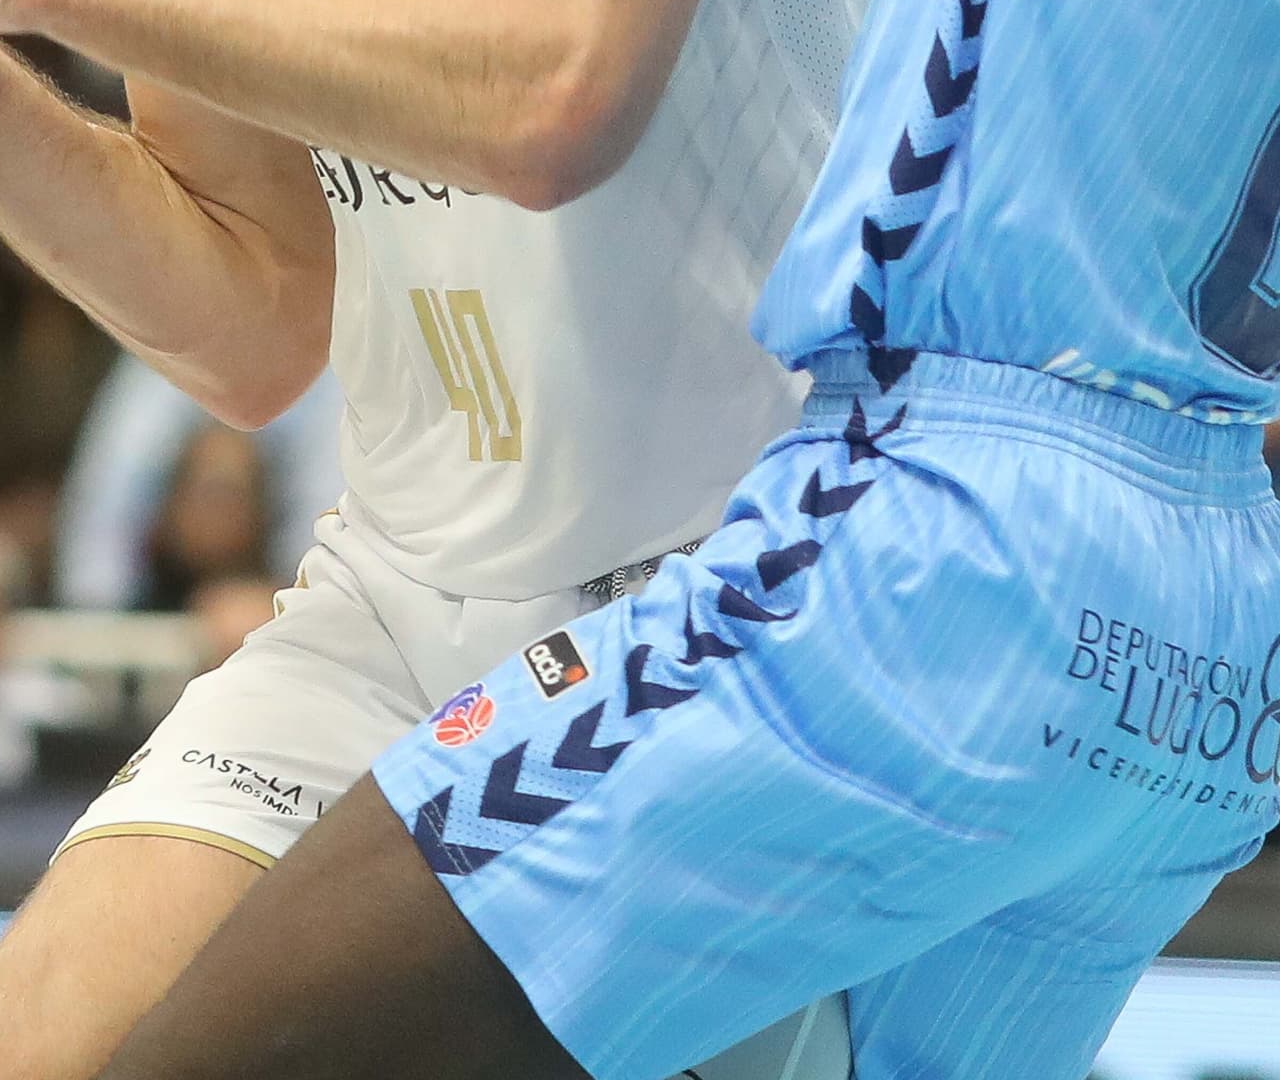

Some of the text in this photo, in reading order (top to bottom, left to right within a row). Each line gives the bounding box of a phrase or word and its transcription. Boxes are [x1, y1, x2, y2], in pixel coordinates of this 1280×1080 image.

[408, 288, 522, 462] 40
[528, 643, 564, 686] acb
[1066, 643, 1120, 693] DE
[229, 777, 262, 799] NOS
